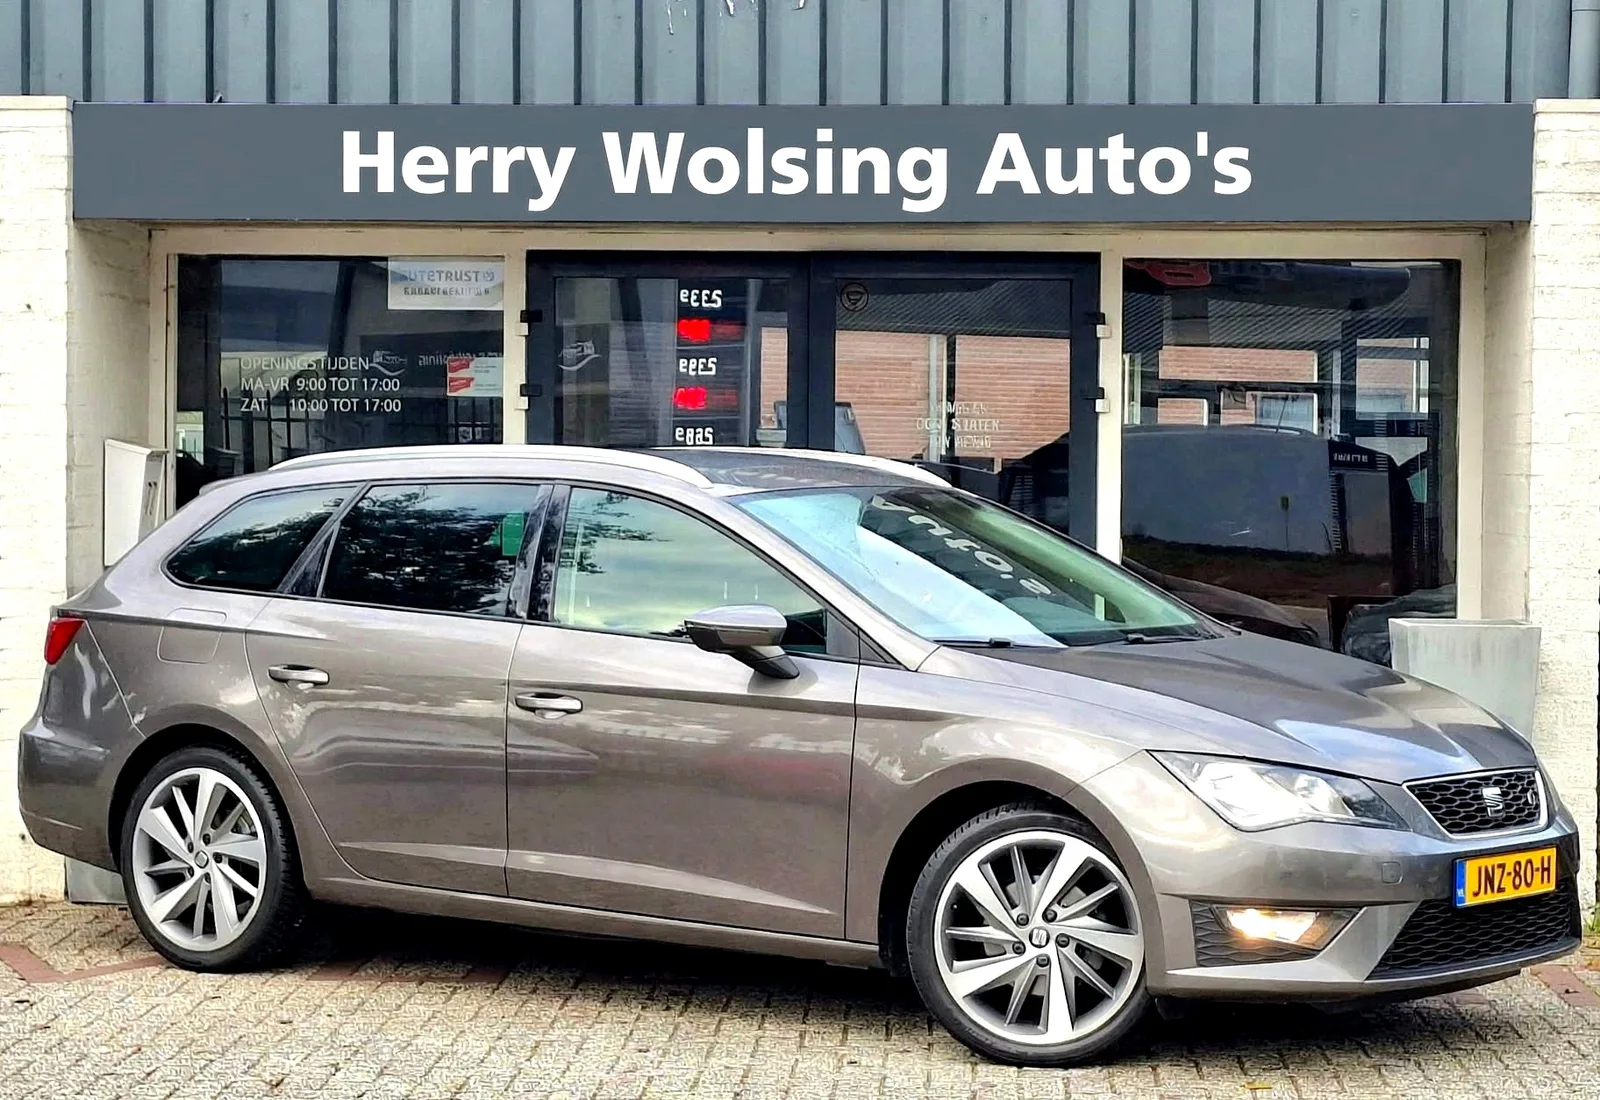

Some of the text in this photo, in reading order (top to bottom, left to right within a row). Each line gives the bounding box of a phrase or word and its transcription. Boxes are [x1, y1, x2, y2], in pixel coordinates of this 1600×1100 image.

[342, 127, 1252, 213] Herry Wolsing Auto's
[240, 356, 369, 371] OPENINGSTIJDEN
[241, 377, 400, 391] MA-VR 9:00 TOT 17:00
[240, 398, 401, 412] ZAT 10:00 TOT 17:00
[1473, 855, 1552, 897] JNZ-80-H
